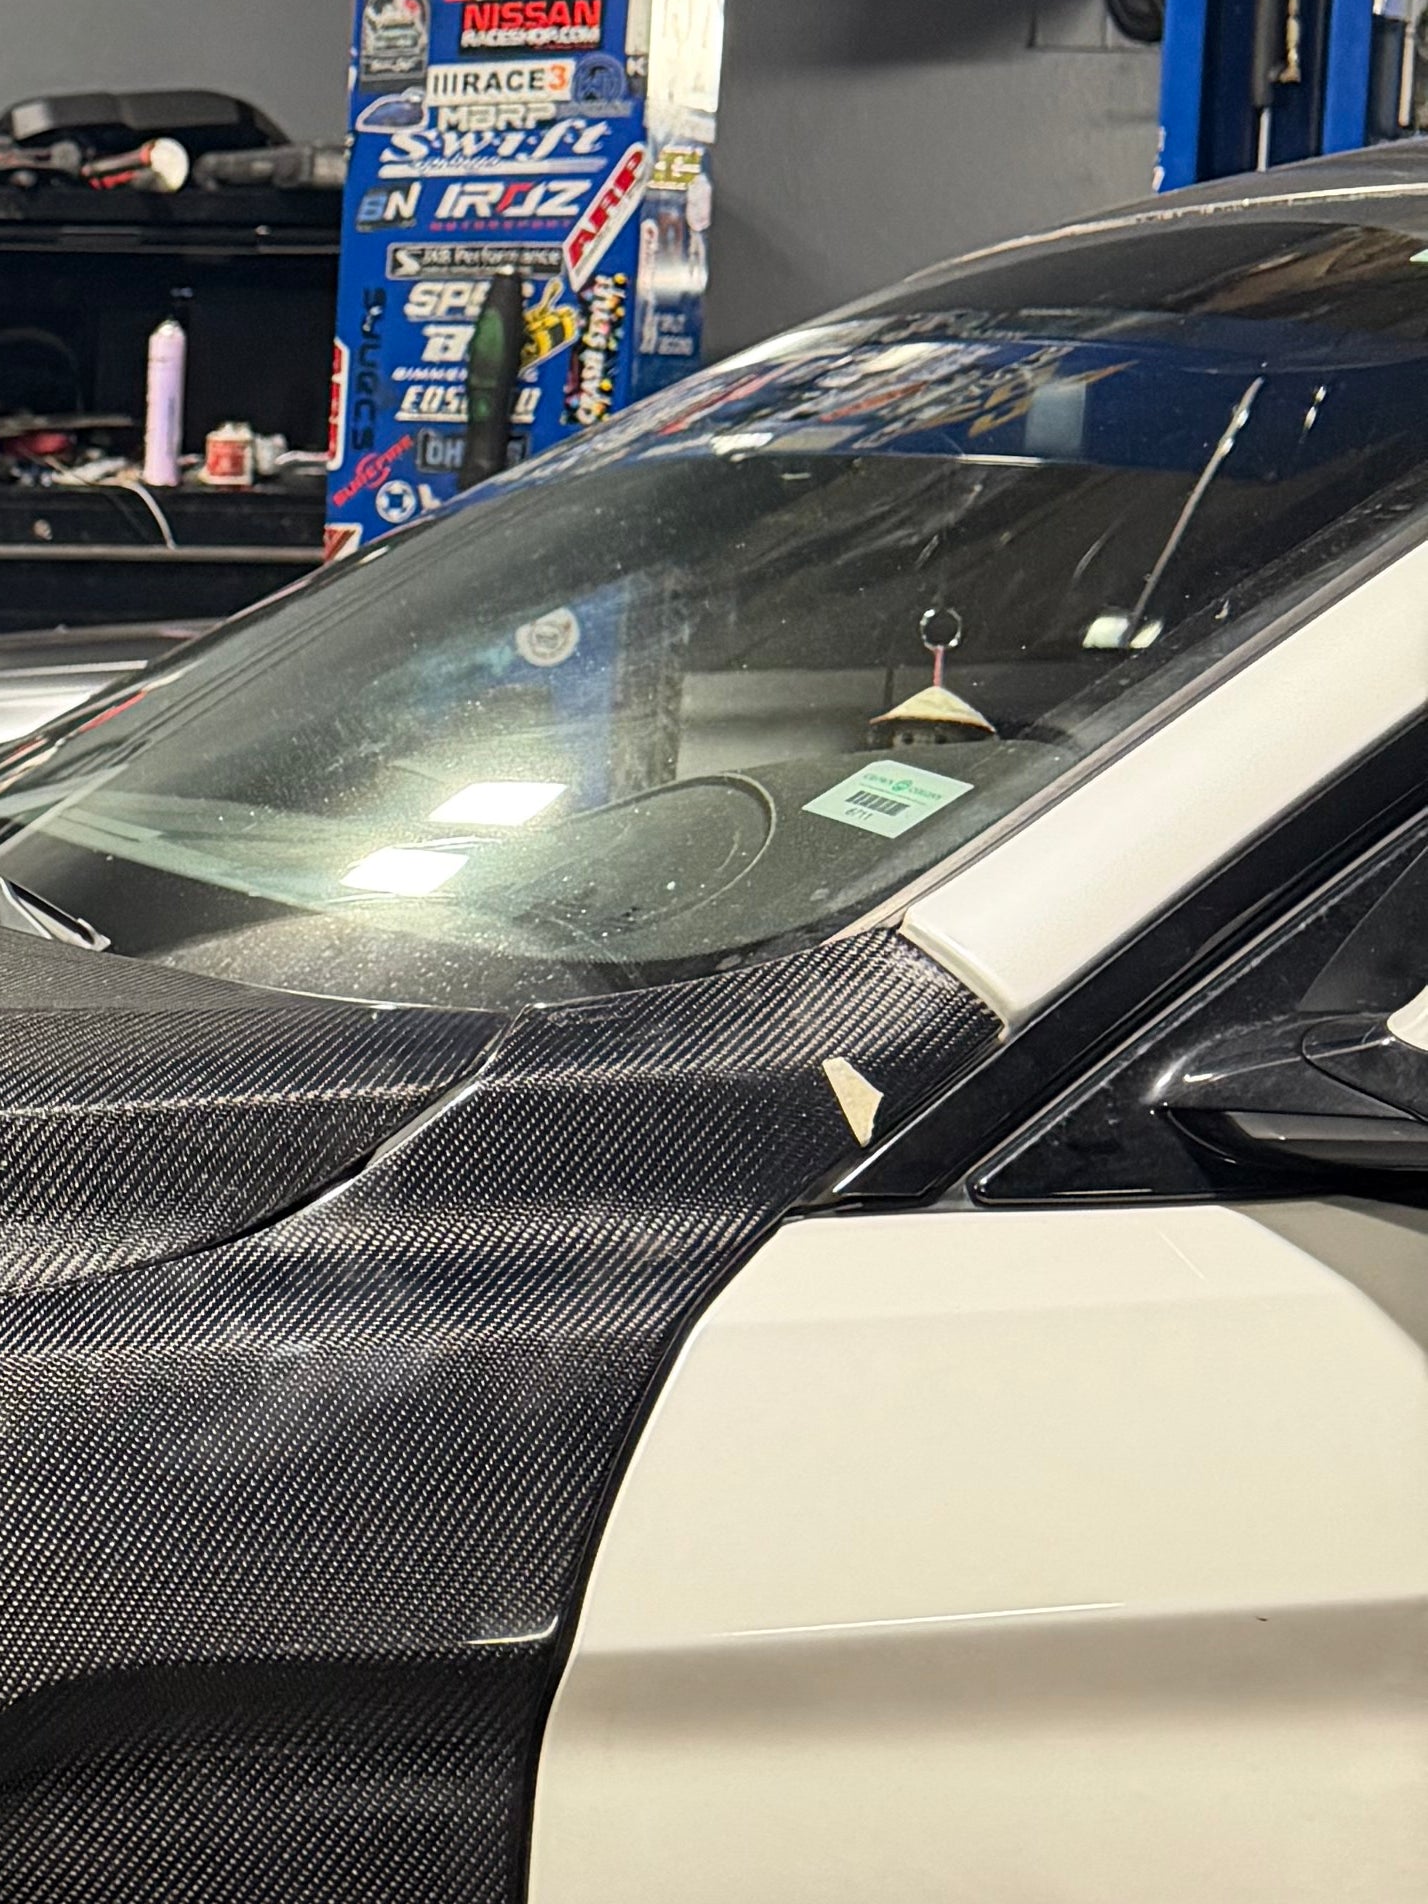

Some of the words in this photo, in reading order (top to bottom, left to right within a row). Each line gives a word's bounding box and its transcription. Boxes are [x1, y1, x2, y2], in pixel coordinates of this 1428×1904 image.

[380, 117, 611, 163] Swift
[438, 102, 557, 133] MBRP
[568, 150, 643, 269] ARP
